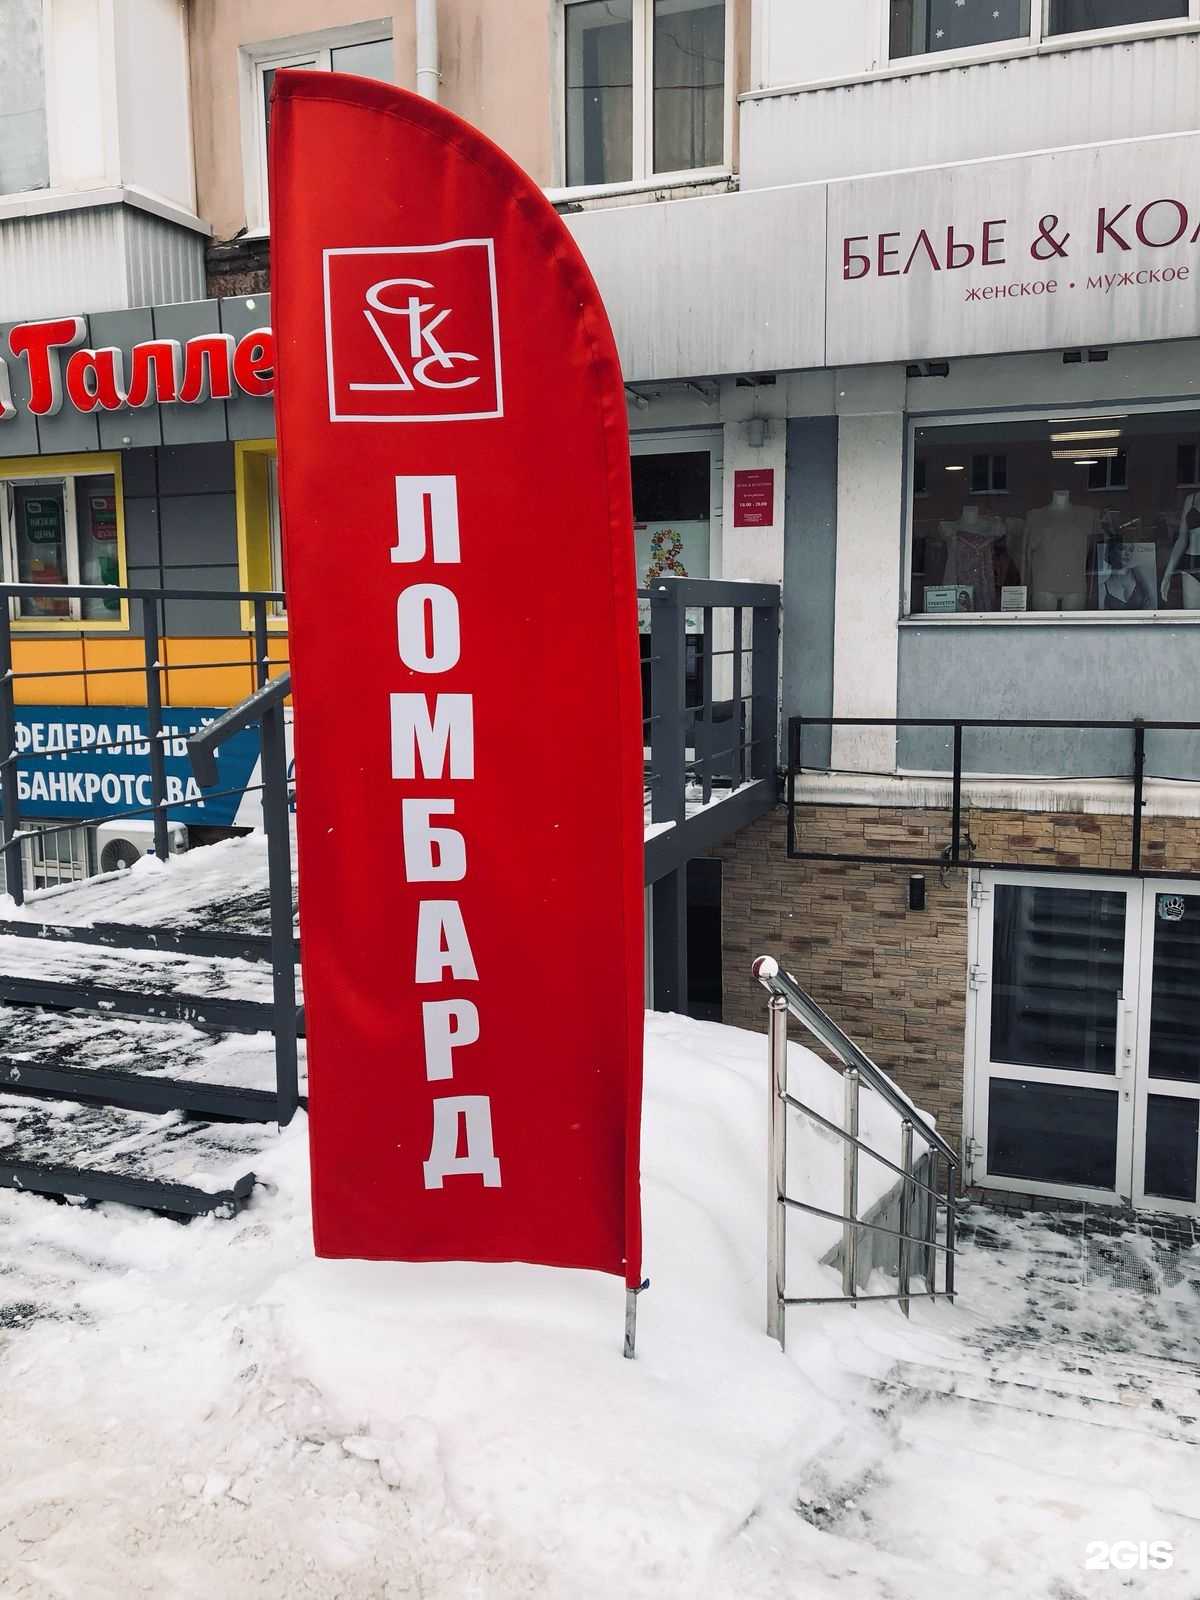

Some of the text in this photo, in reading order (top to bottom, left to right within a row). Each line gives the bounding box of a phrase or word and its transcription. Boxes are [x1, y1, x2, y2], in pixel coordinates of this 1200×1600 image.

[843, 199, 1200, 280] БЕЛЬЕ & КО
[965, 266, 1190, 301] женское мужское
[17, 770, 205, 808] БАНКРОТСВА
[390, 475, 502, 1190] ЛОМБАРД
